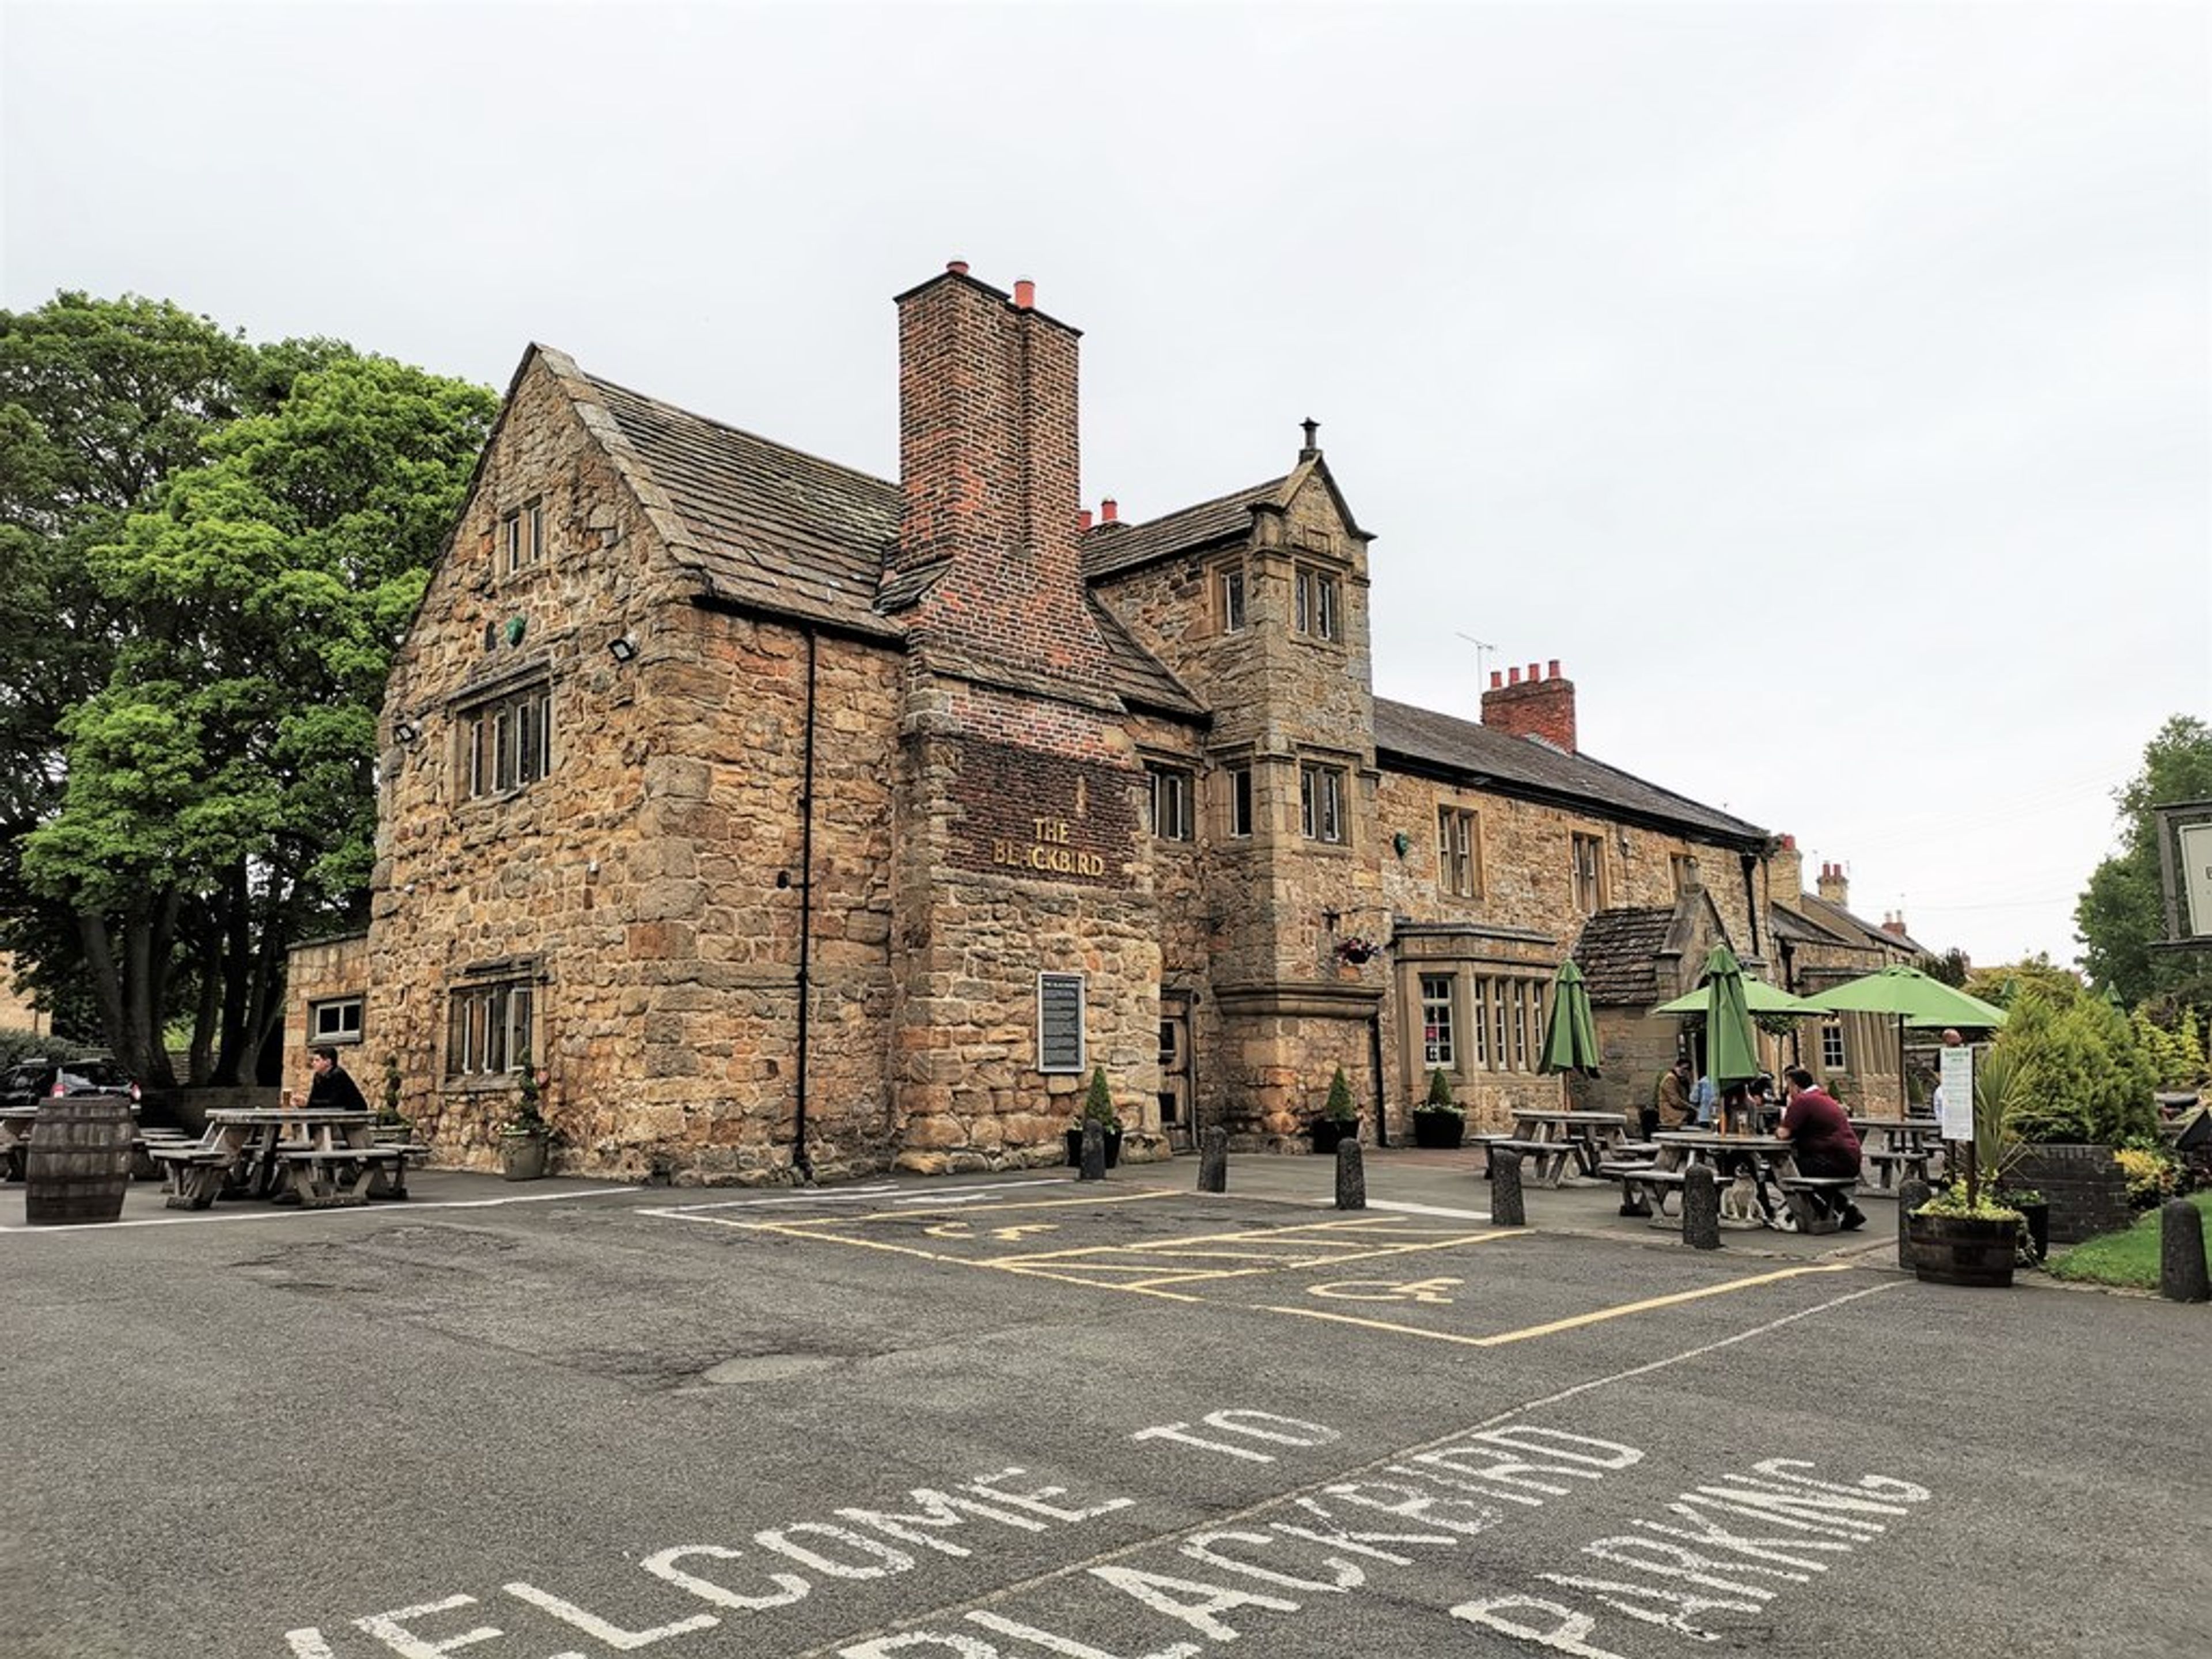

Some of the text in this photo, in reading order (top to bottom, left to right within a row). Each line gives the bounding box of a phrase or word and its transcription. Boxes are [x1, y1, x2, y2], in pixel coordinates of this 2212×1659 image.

[993, 839, 1104, 876] BLACKBIRD
[1033, 817, 1070, 843] THE
[285, 1409, 1342, 1659] ELCOME TO
[1449, 1459, 1931, 1659] PARKING
